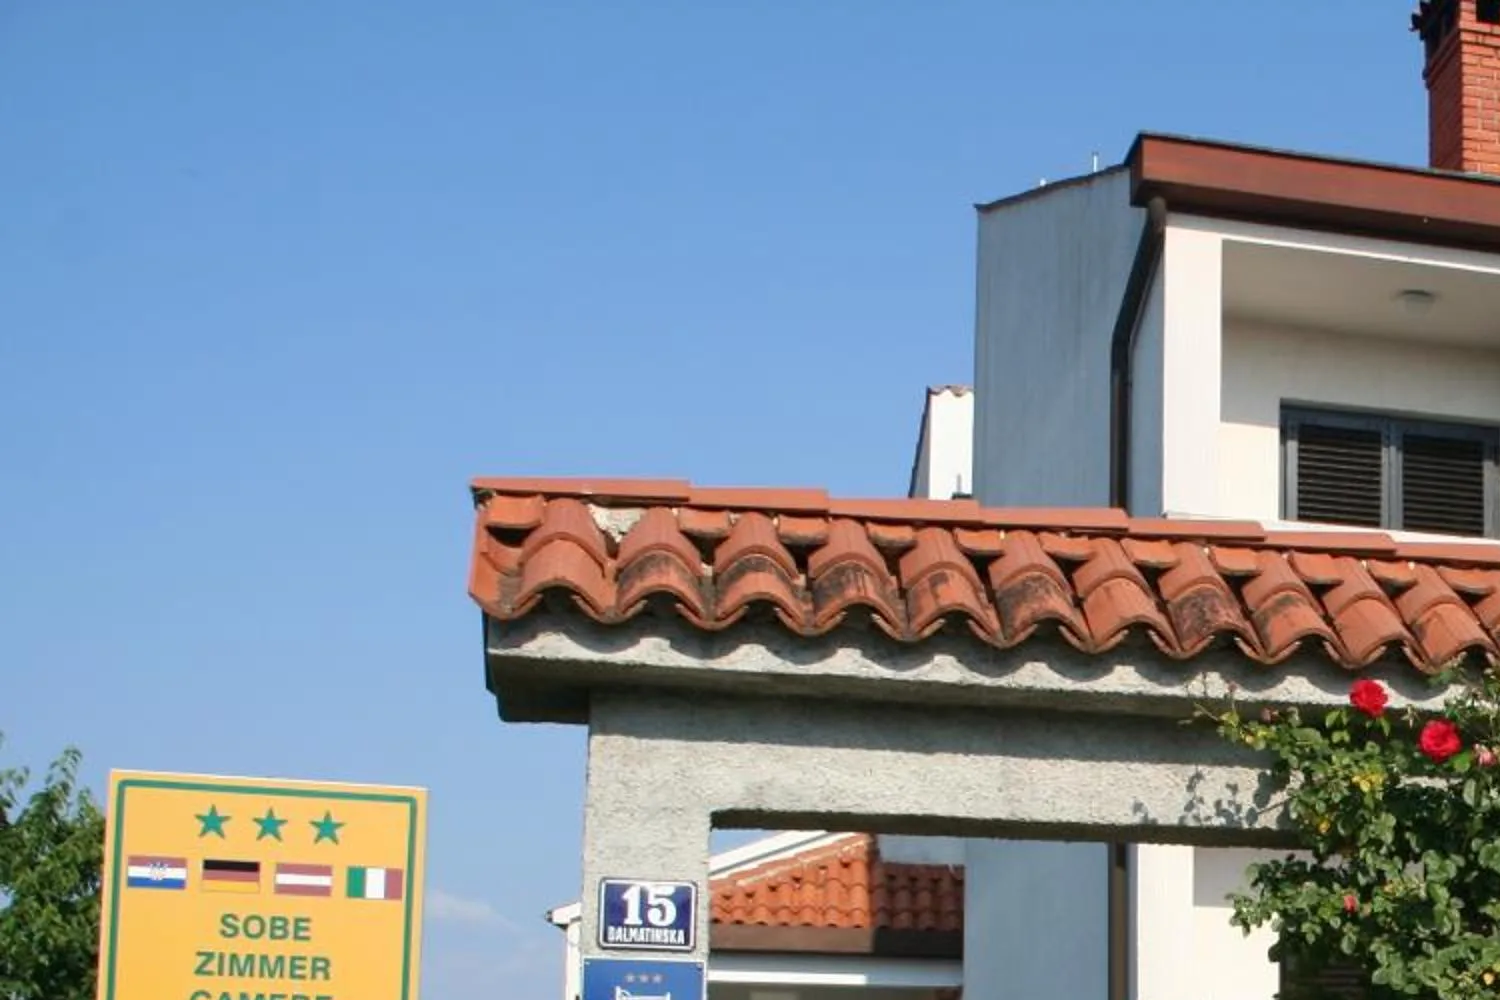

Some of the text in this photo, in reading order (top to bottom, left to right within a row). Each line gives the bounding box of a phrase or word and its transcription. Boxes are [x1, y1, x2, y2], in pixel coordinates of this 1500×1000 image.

[621, 884, 678, 927] 15
[219, 914, 312, 942] SOBE
[607, 926, 685, 945] DALMATINSKA
[194, 951, 331, 981] ZIMMER
